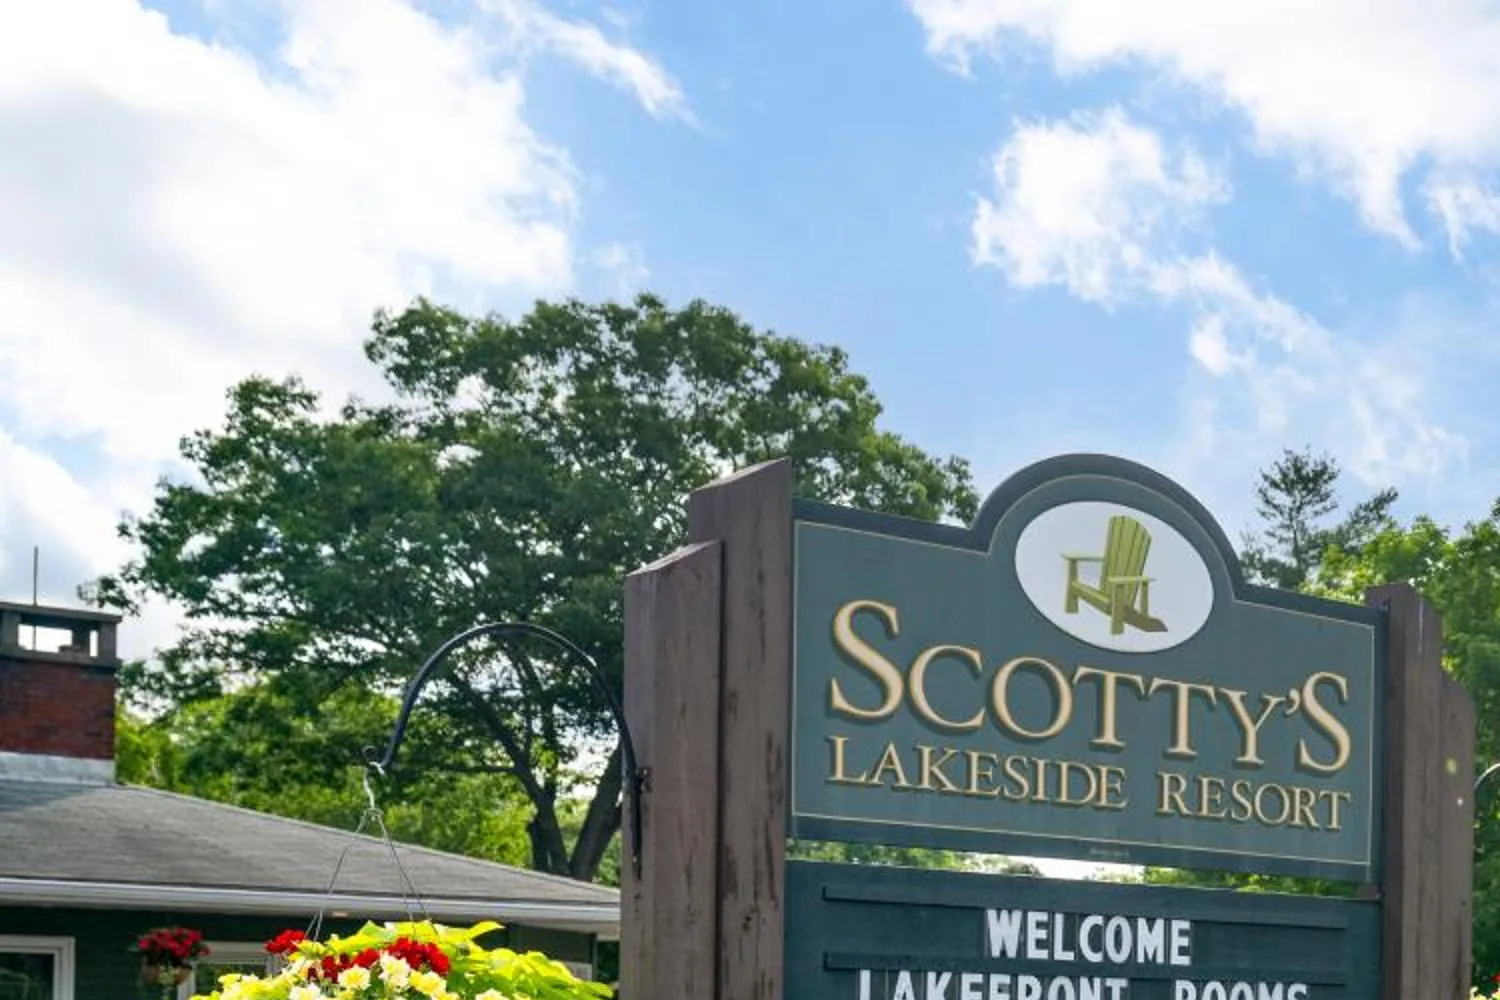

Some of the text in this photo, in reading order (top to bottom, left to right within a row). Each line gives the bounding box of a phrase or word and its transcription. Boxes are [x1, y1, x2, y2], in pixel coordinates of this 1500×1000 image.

[830, 600, 1352, 774] SCOTTY'S
[829, 736, 1351, 831] LAKESIDE RESORT
[987, 908, 1193, 966] WELCOME
